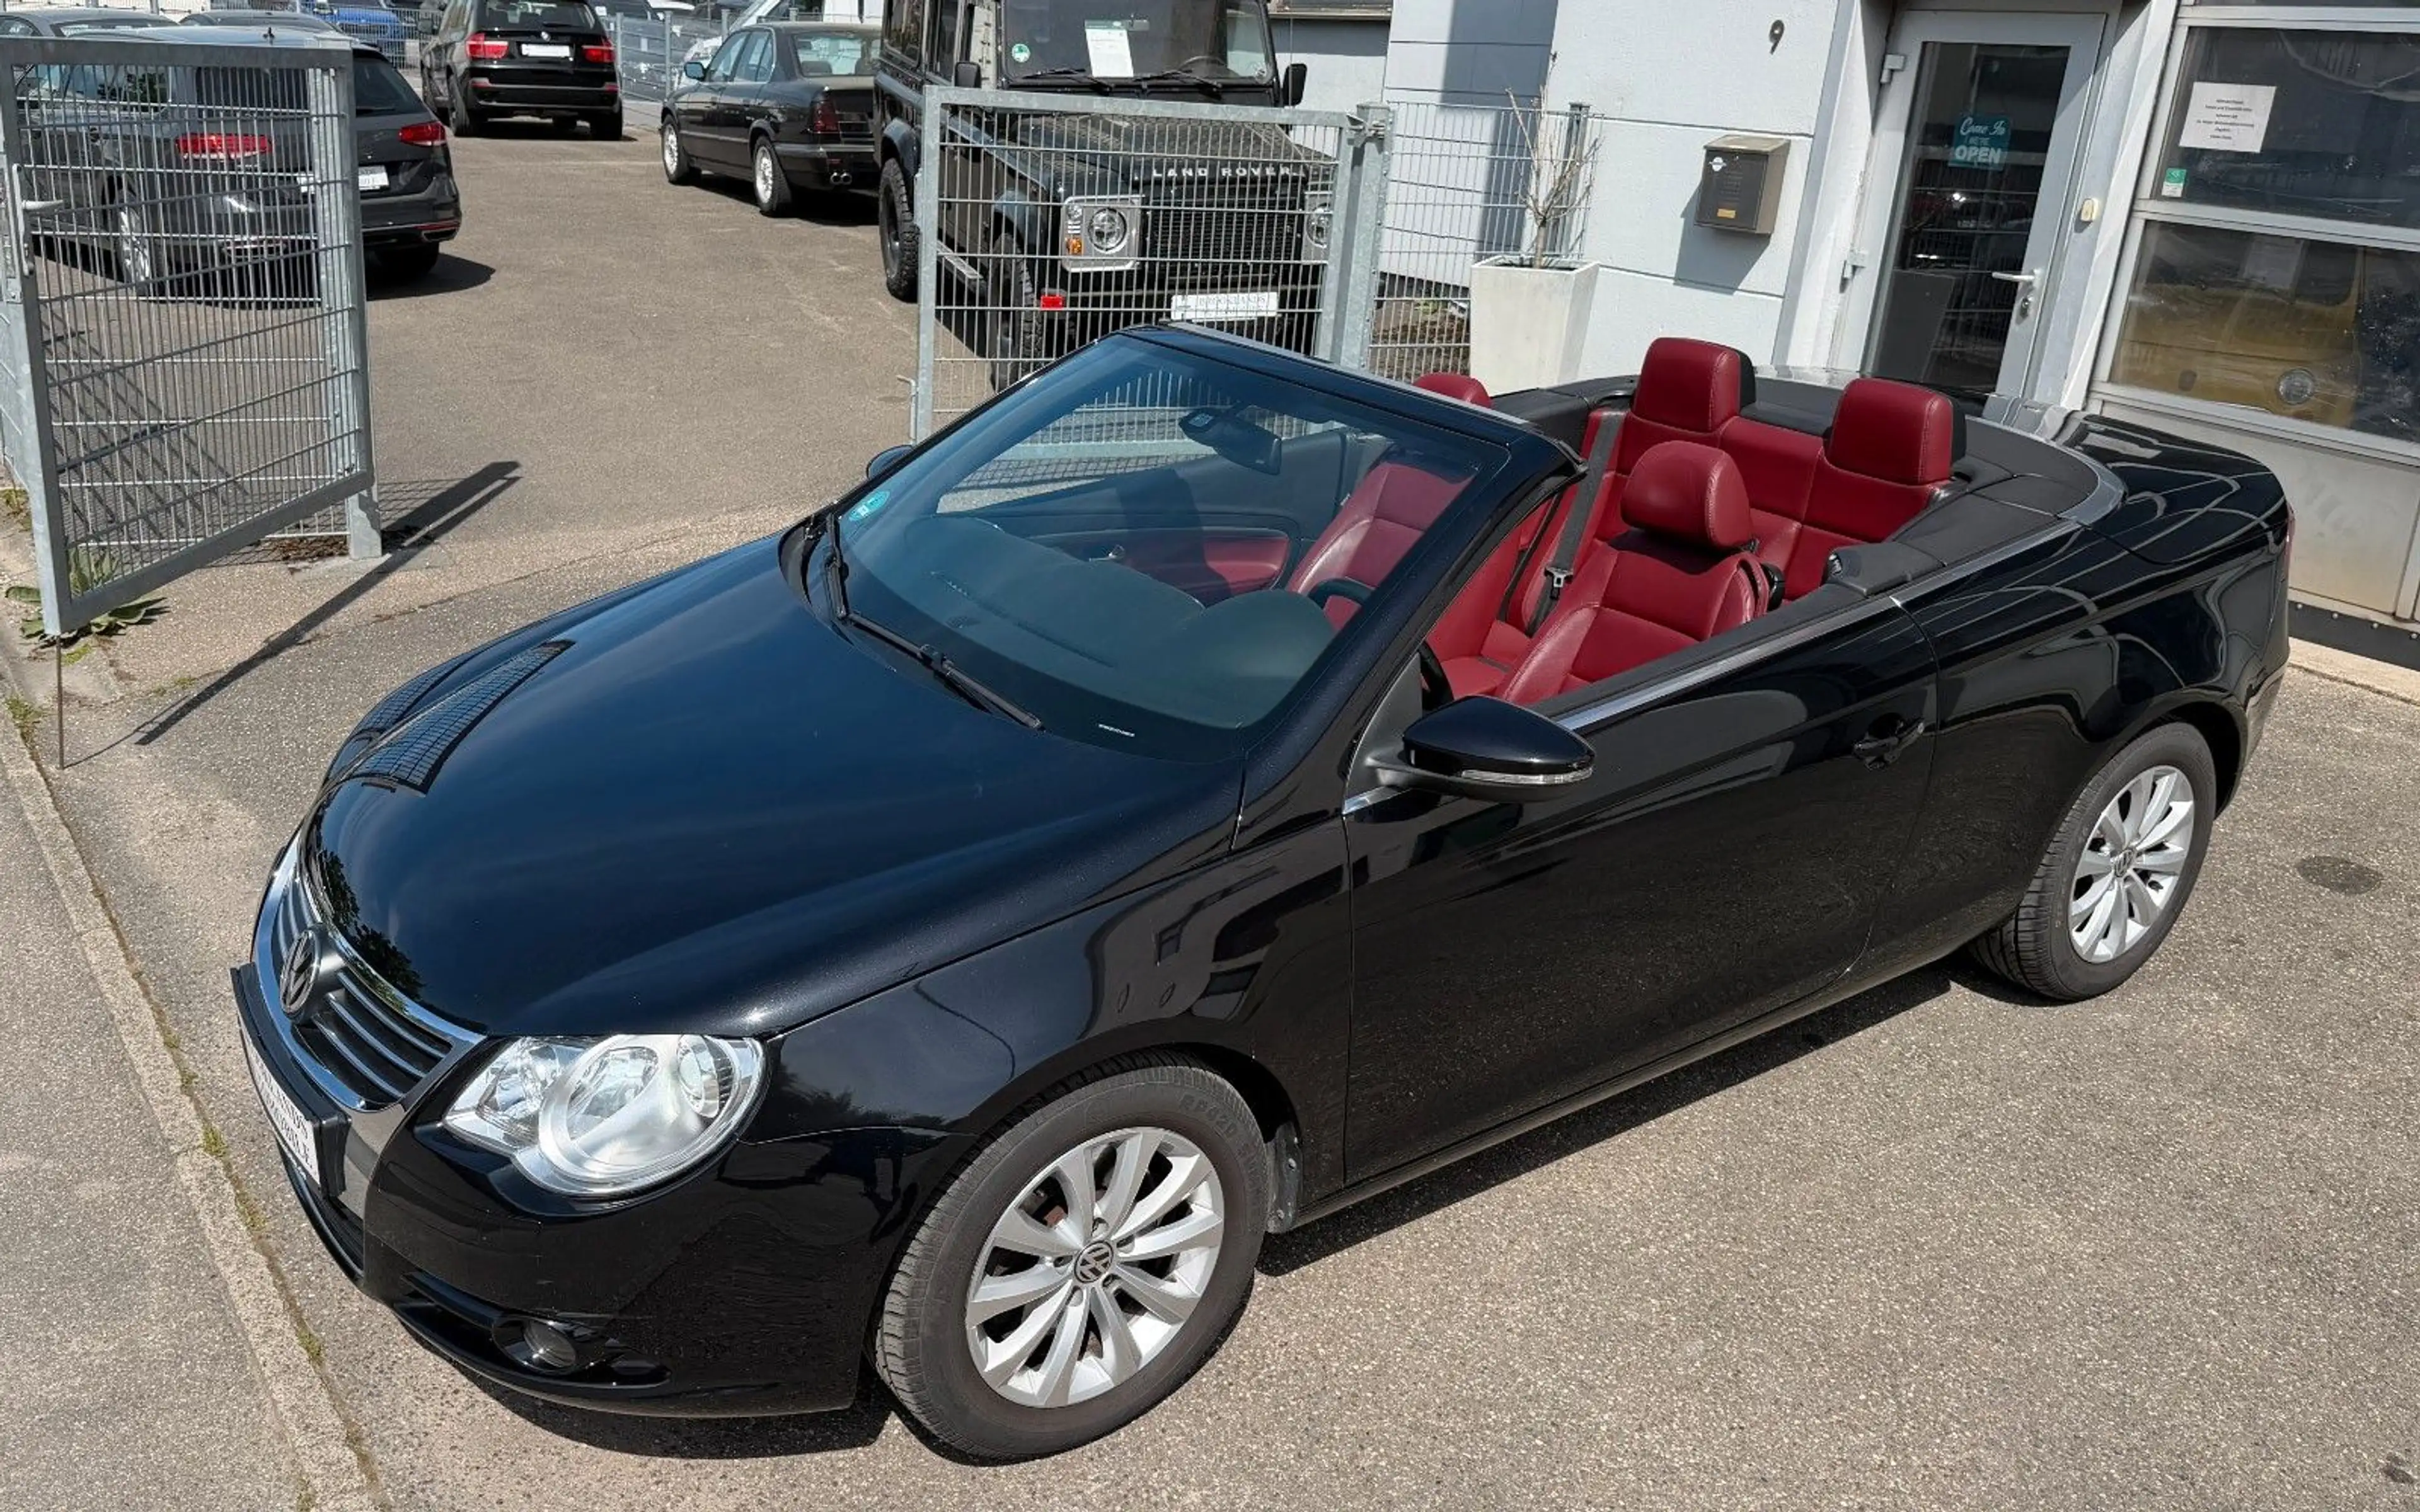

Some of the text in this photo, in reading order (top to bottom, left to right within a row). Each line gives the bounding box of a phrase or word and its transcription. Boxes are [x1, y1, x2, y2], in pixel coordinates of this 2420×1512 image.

[1768, 20, 1785, 55] 9
[1960, 117, 2005, 135] Come In
[1955, 145, 2002, 164] OPEN
[1153, 166, 1291, 178] LAND ROVER
